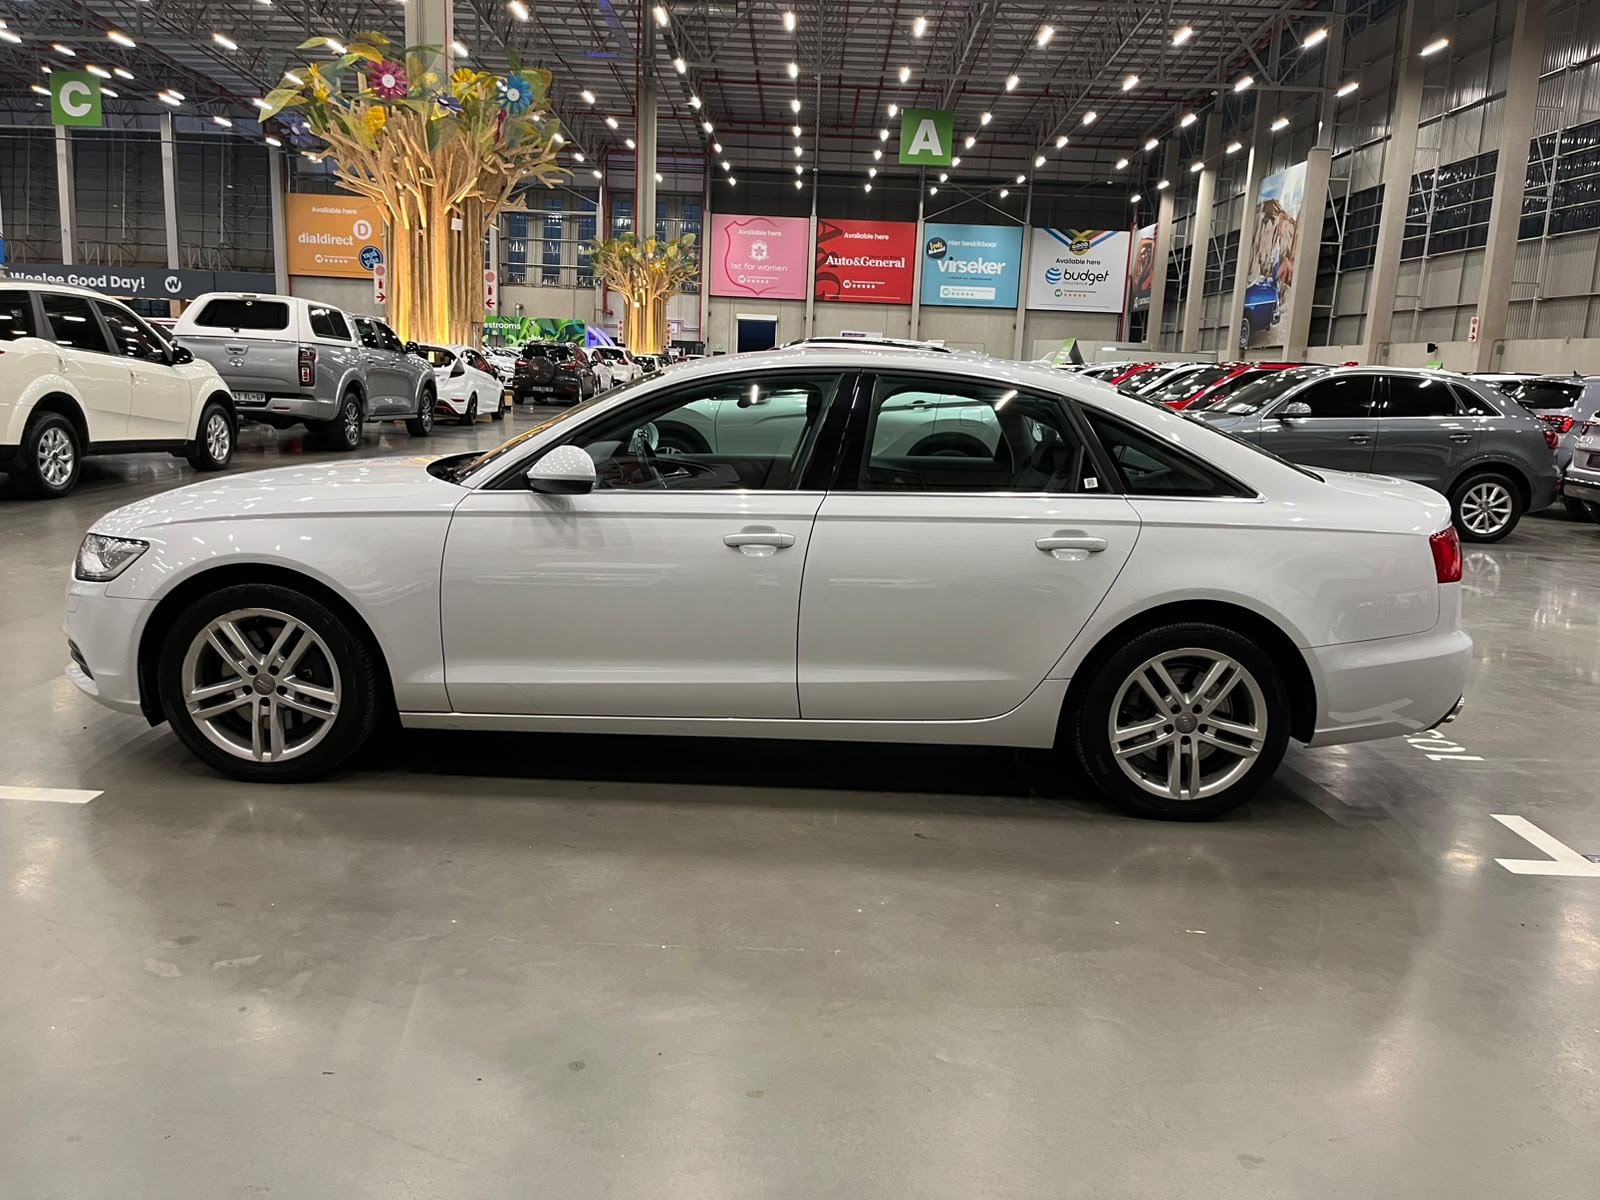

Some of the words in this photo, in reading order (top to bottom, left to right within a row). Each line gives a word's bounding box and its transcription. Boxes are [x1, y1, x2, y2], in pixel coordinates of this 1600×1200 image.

[60, 81, 92, 117] C
[908, 119, 943, 156] A
[312, 206, 341, 214] Available
[342, 207, 357, 215] here
[298, 232, 354, 246] dialdirect
[844, 232, 873, 240] Available
[730, 262, 742, 270] 1st
[757, 264, 788, 272] women
[825, 255, 905, 268] Auto&General
[937, 256, 1006, 274] virseker
[68, 274, 106, 288] Good
[110, 275, 146, 293] Day!
[1063, 269, 1109, 285] budget
[483, 321, 521, 330] estrooms
